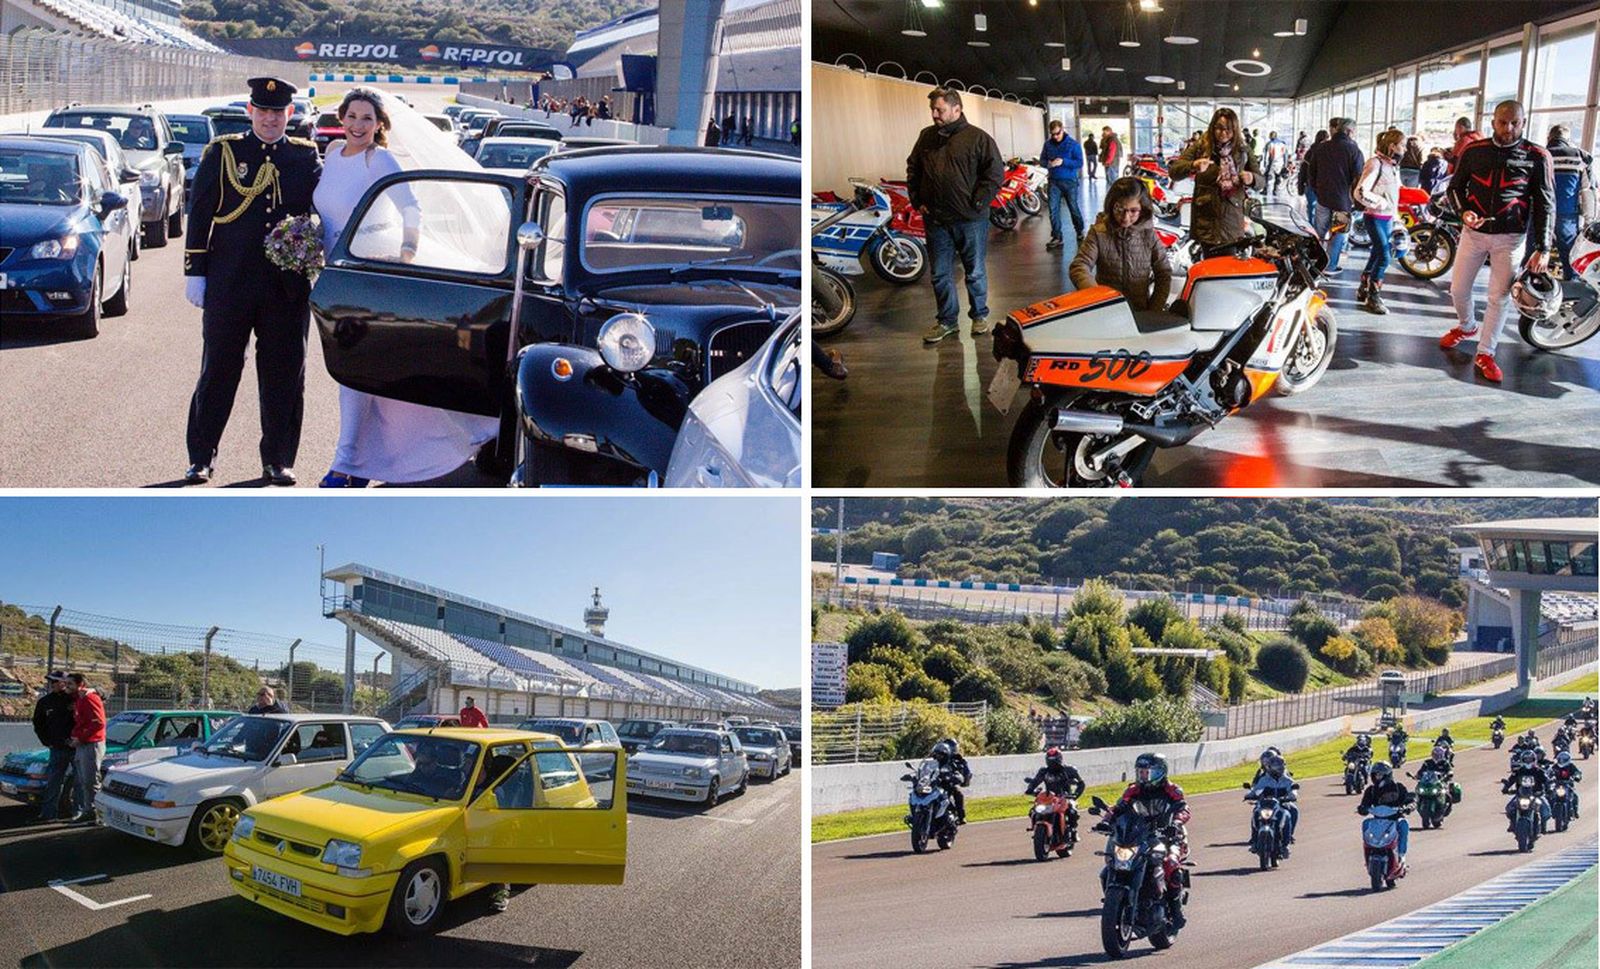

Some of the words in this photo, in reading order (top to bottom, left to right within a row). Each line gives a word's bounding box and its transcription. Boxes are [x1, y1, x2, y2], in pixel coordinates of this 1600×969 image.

[318, 43, 399, 58] REPSOL
[443, 46, 524, 66] REPSOL
[1050, 360, 1080, 371] RD
[1079, 348, 1152, 383] 500
[257, 868, 278, 887] 7454
[280, 876, 298, 894] FVH
